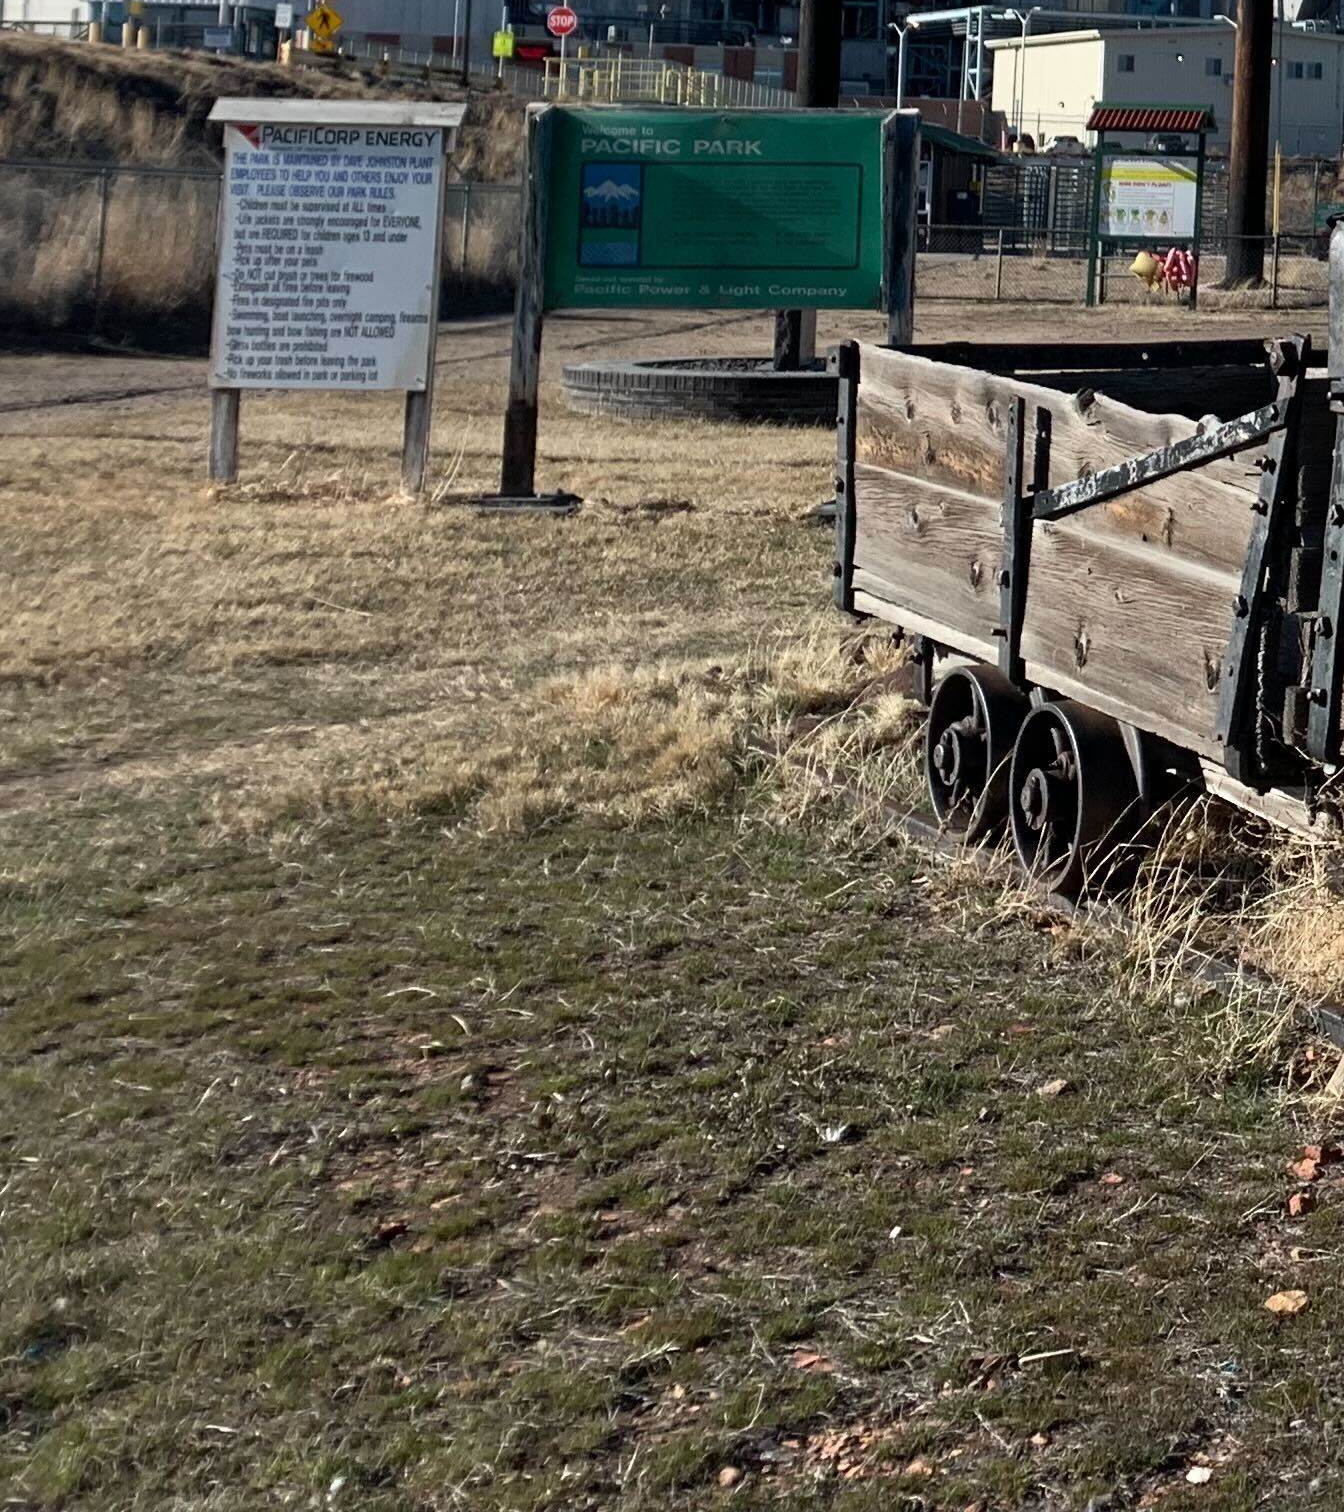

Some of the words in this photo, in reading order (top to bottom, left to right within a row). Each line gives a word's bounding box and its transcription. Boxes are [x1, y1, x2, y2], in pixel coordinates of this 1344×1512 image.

[550, 15, 574, 27] STOP
[582, 125, 636, 136] Welcome
[641, 126, 654, 136] to
[365, 130, 436, 147] ENERGY
[581, 139, 681, 155] PACIFIC
[693, 139, 763, 155] PARK
[233, 152, 248, 165] THE
[250, 152, 270, 165] PARK
[282, 153, 328, 166] MAINTAINED
[366, 155, 407, 168] JOHNSTON
[409, 156, 434, 169] PLANT
[230, 167, 276, 180] EMPLOYEES
[280, 169, 289, 181] TO
[292, 169, 312, 181] HELP
[315, 170, 330, 182] YOU
[332, 171, 348, 182] AND
[351, 171, 382, 184] OTHERS
[384, 172, 410, 184] ENJOY
[411, 172, 432, 184] YOUR
[256, 184, 286, 196] PLEASE
[289, 185, 325, 197] OBSERVE
[327, 186, 345, 198] OUR
[347, 186, 367, 198] PARK
[302, 200, 340, 213] supervised
[352, 201, 364, 213] ALL
[367, 202, 386, 213] times
[253, 215, 280, 227] jackets
[282, 216, 294, 226] are
[297, 216, 325, 228] strongly
[327, 216, 368, 229] encouraged
[261, 228, 298, 241] REQUIRED
[313, 229, 341, 241] children
[387, 232, 408, 243] under
[247, 268, 261, 281] NOT
[343, 270, 374, 283] firewood
[300, 282, 324, 294] before
[326, 283, 350, 296] leaving
[574, 284, 632, 295] Pacific
[639, 284, 689, 295] Power
[720, 284, 760, 296] Light
[768, 284, 847, 297] Company
[262, 295, 299, 309] designated
[329, 312, 362, 326] overnight
[272, 326, 285, 337] and
[287, 326, 302, 338] bow
[344, 326, 359, 339] NOT
[361, 326, 396, 339] ALLOWED
[292, 340, 328, 354] prohibited
[295, 355, 318, 367] before
[321, 356, 345, 369] leaving
[240, 368, 272, 381] fireworks
[274, 369, 301, 381] allowed
[340, 371, 367, 385] parking
